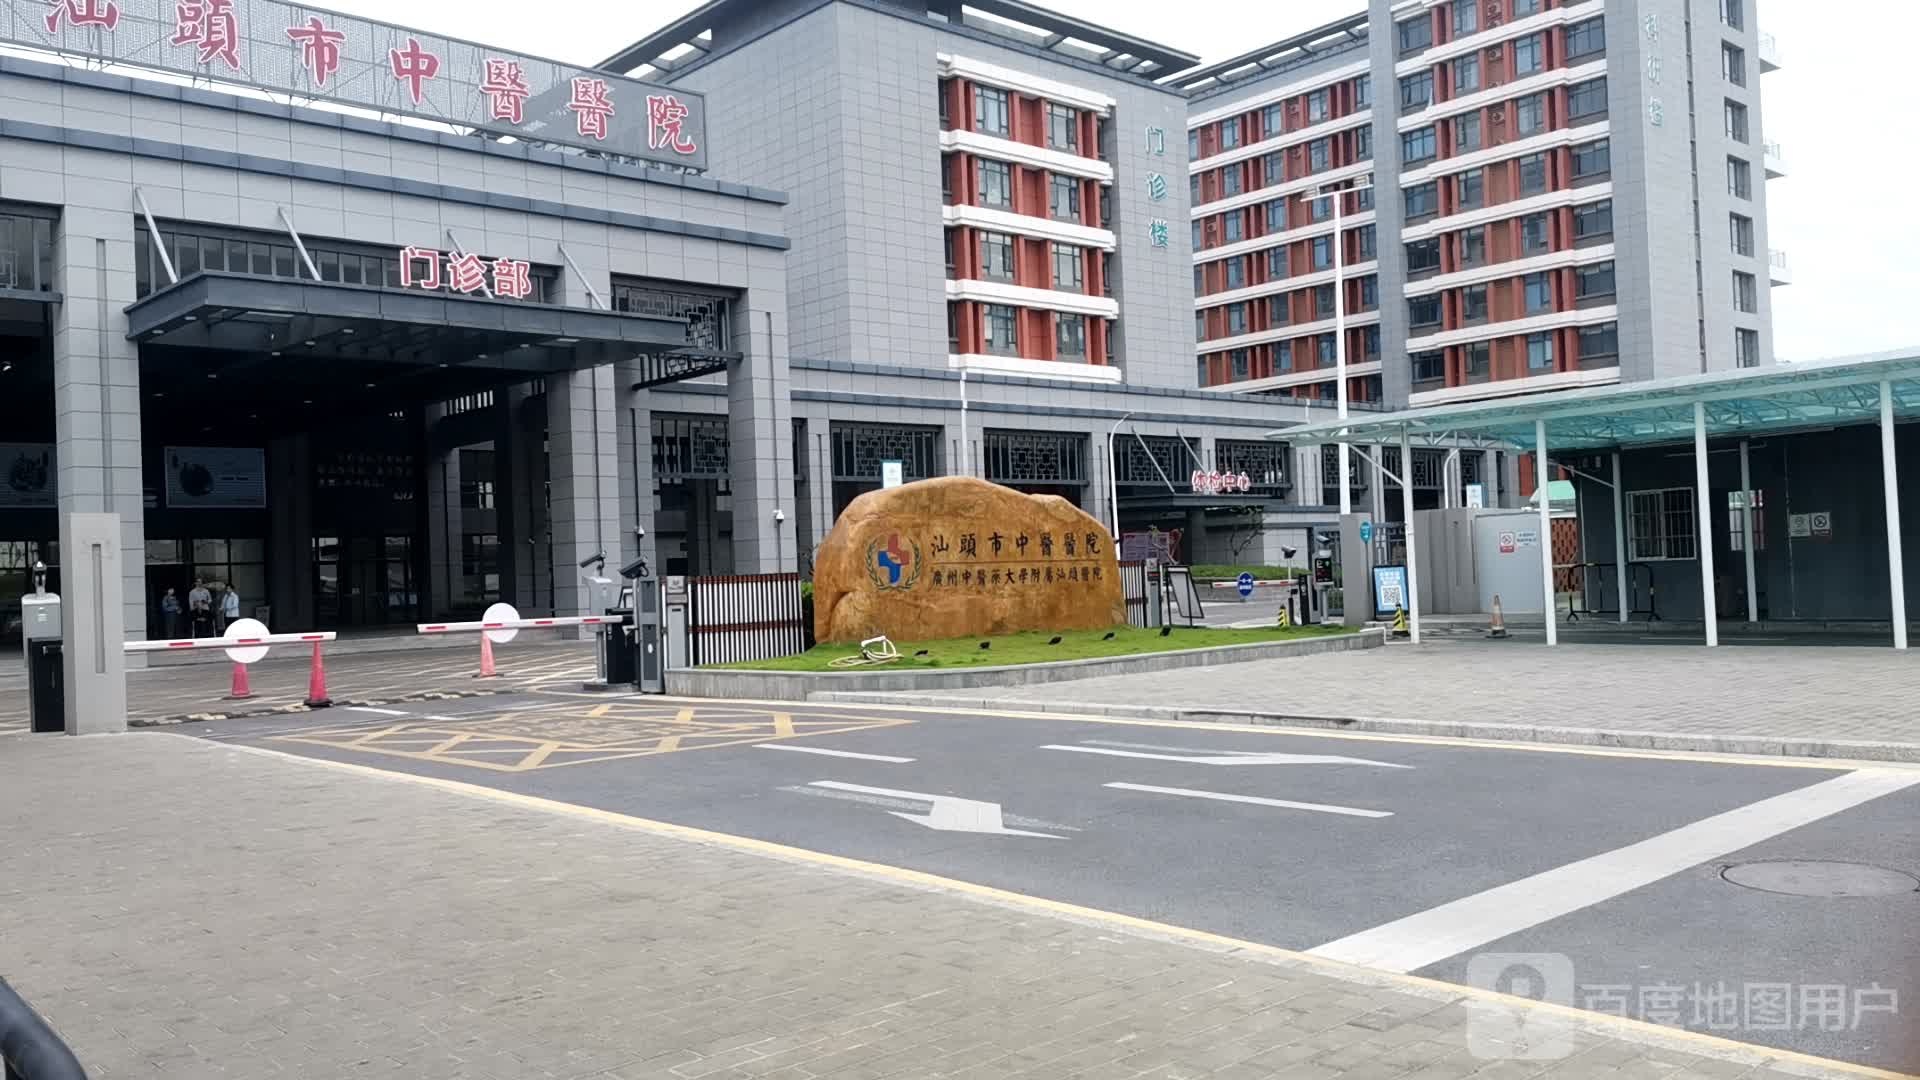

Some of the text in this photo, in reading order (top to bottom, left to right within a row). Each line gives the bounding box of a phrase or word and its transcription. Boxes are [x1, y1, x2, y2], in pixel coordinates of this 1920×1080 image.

[1145, 126, 1168, 249] 门诊楼
[400, 245, 532, 299] 门诊部
[930, 531, 1101, 558] 汕頭市中醫醫院
